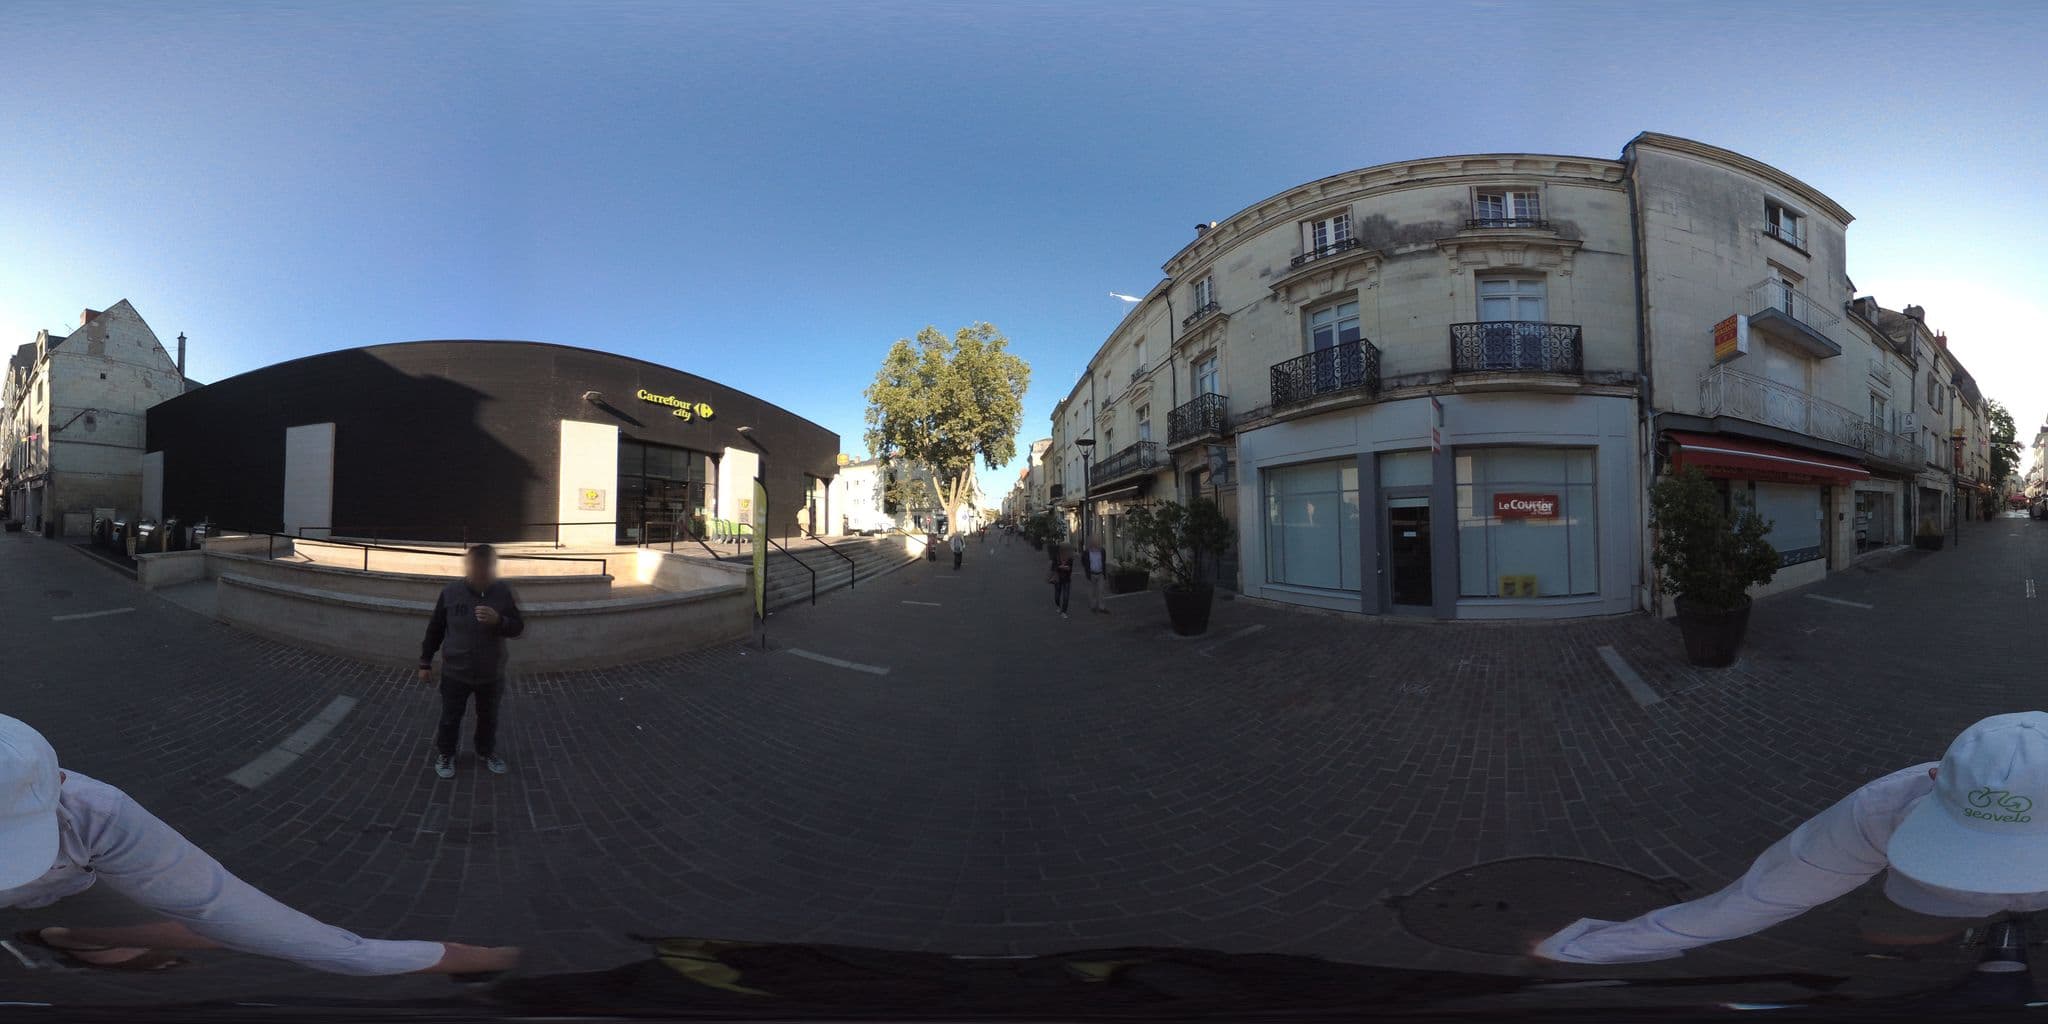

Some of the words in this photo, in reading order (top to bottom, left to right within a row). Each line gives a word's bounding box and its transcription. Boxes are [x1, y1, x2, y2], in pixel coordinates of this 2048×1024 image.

[637, 389, 691, 410] Carrefour
[672, 409, 691, 421] city
[1499, 502, 1509, 510] Le
[1964, 807, 2031, 823] geovelo
